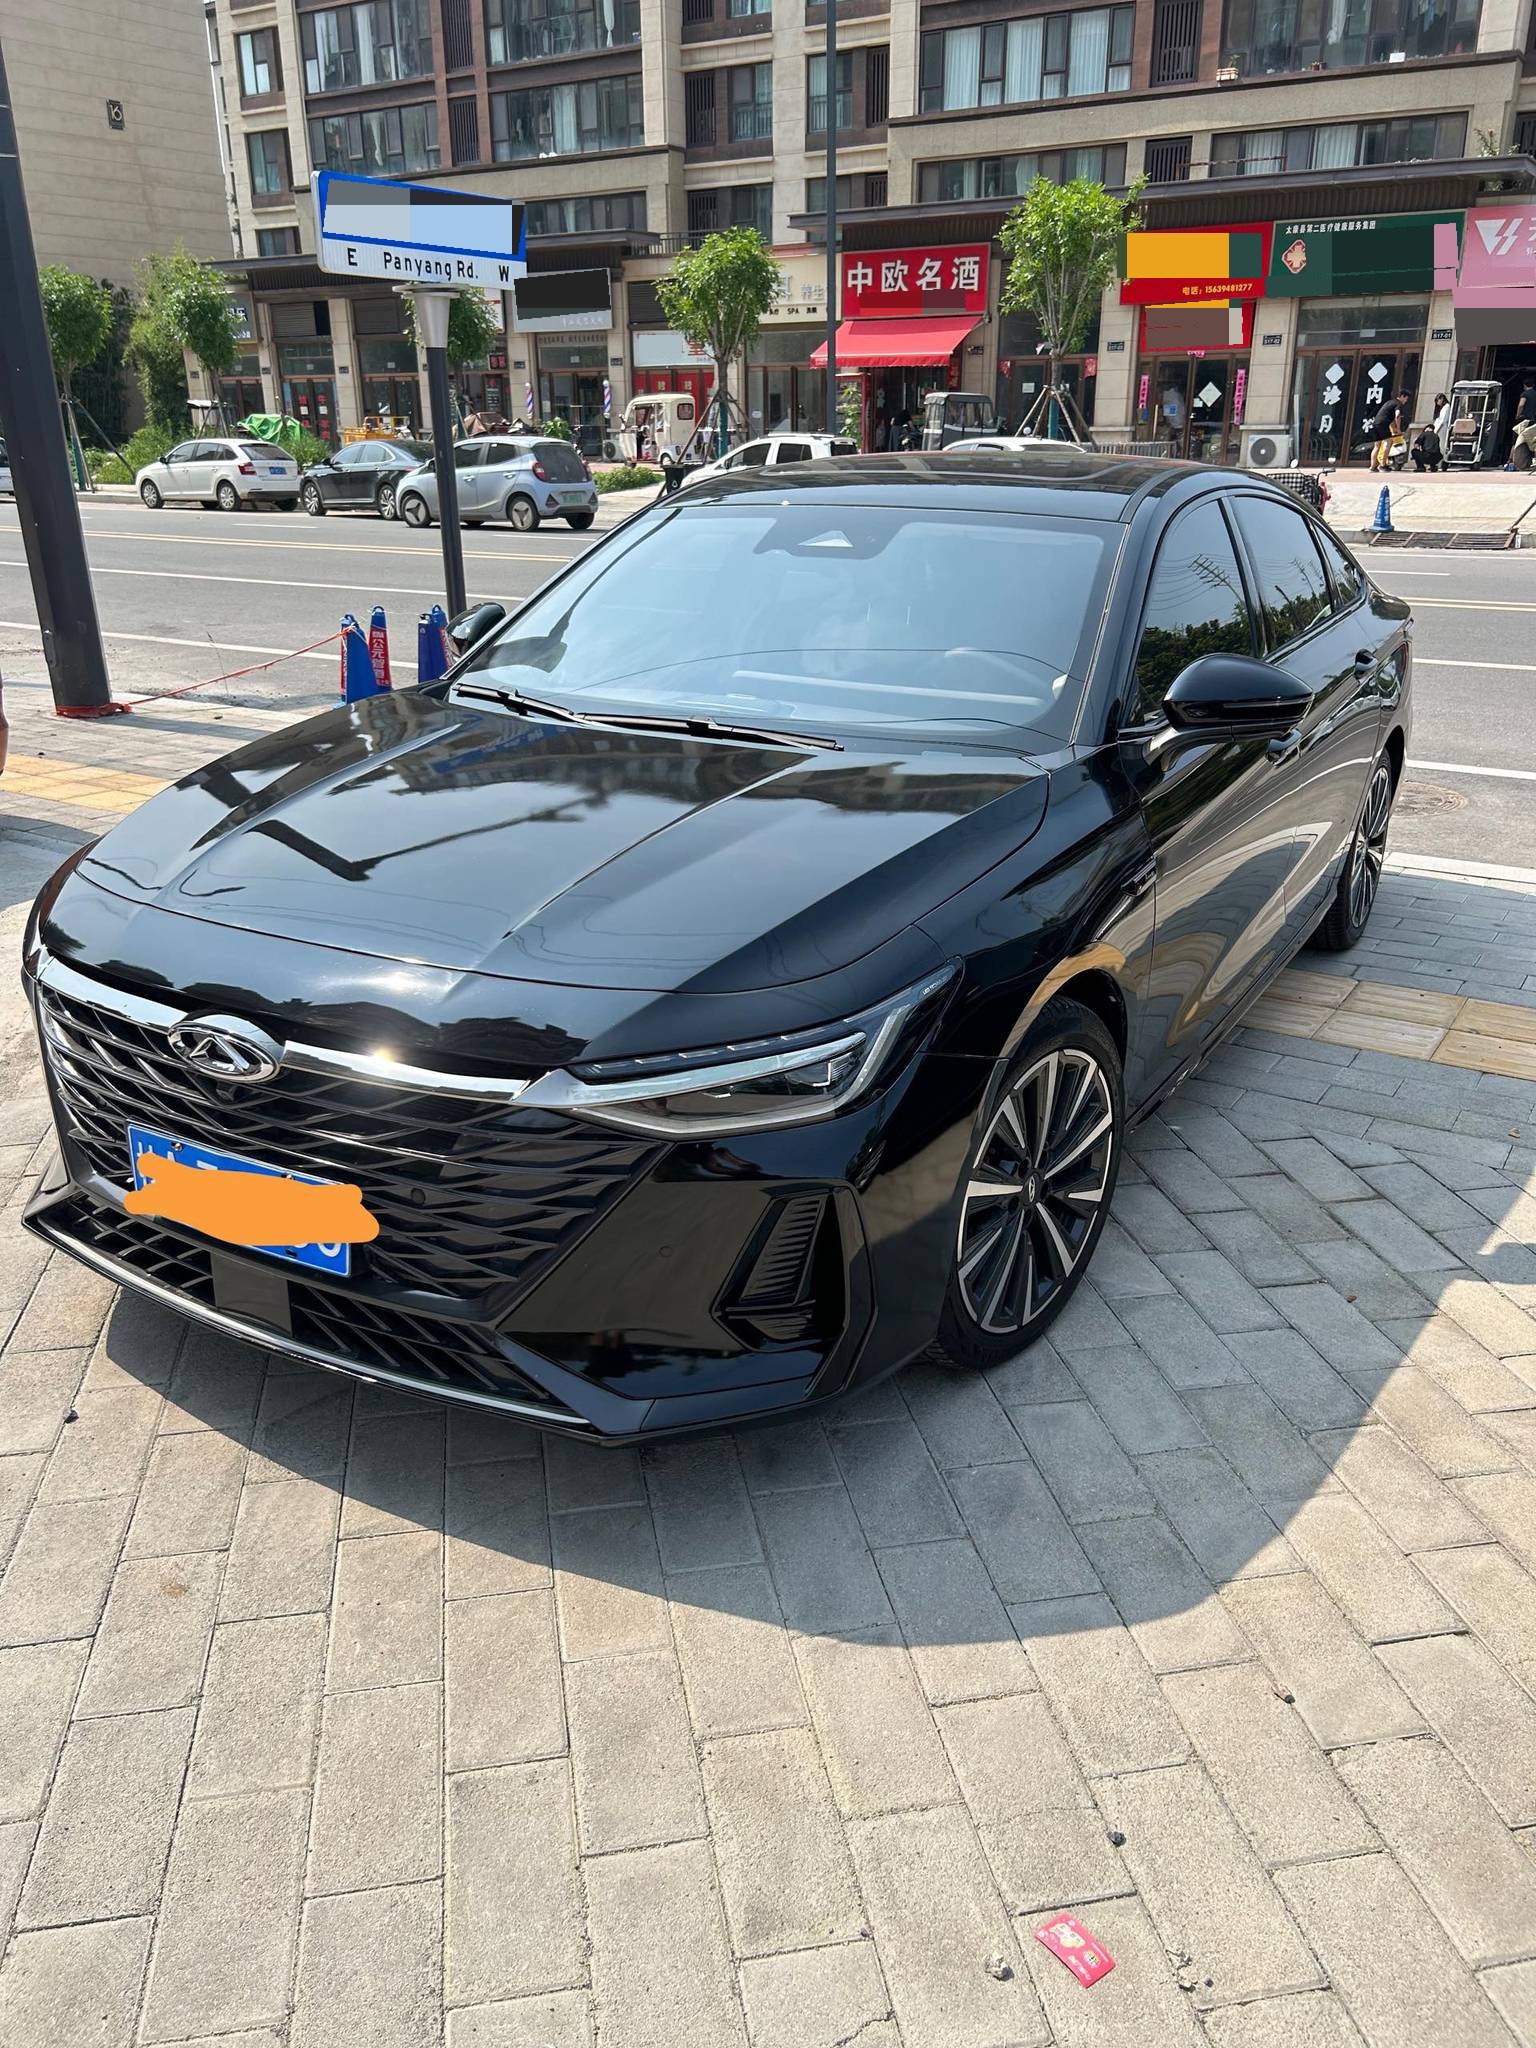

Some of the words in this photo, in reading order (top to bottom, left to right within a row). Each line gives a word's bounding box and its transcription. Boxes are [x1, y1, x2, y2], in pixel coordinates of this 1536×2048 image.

[347, 247, 358, 267] E
[383, 251, 453, 281] Panyang
[457, 260, 479, 280] Rd.
[498, 264, 510, 283] W
[847, 255, 981, 297] 中欧名酒
